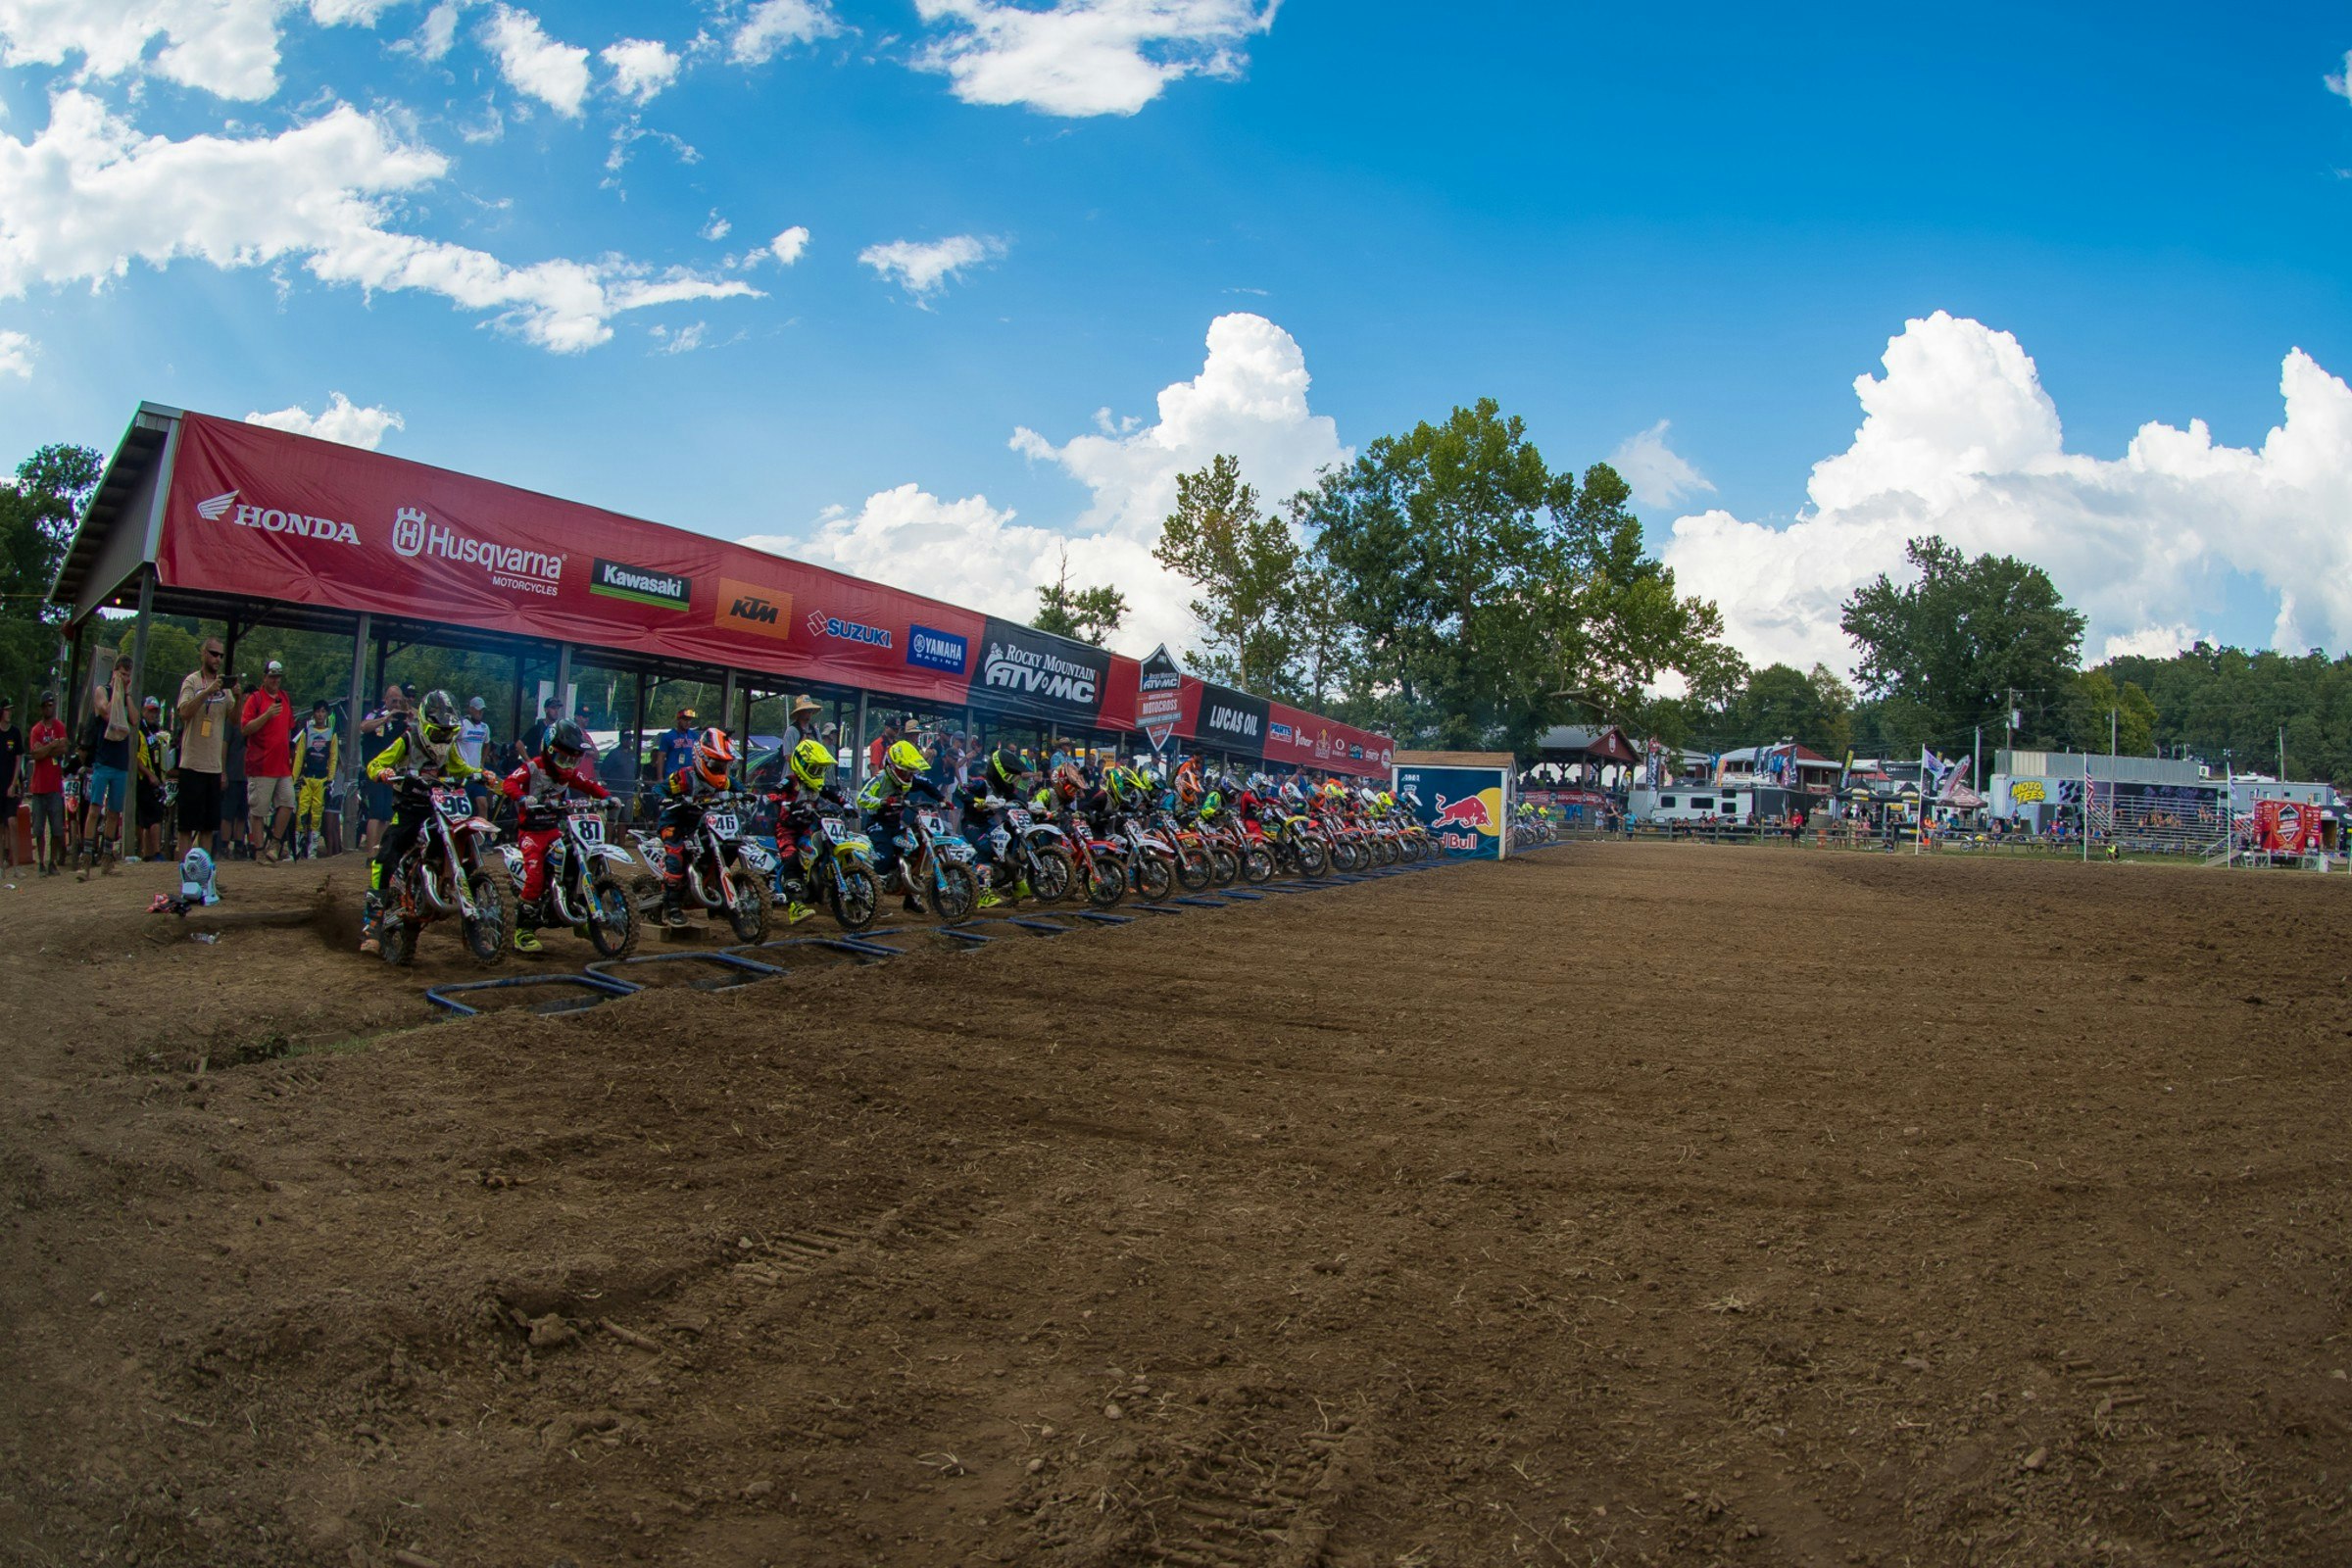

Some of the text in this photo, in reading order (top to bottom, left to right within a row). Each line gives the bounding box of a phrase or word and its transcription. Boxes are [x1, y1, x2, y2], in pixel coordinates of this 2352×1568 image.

[234, 504, 361, 545] HONDA
[427, 524, 563, 580] Husqvarna
[493, 576, 559, 596] MOTORCYCLES
[604, 564, 682, 598] Kawasaki
[729, 596, 779, 624] KTM
[826, 617, 893, 649] SUZUKI
[925, 636, 962, 662] YAMAHA
[915, 653, 959, 666] RACING
[1005, 644, 1097, 681] ROCKY MOUNTAIN
[1143, 700, 1178, 715] MOTOCROSS
[1209, 705, 1258, 736] LUCAS OIL
[2012, 781, 2042, 796] MOTO
[2016, 791, 2045, 805] TEES
[442, 795, 471, 815] 96
[579, 821, 602, 842] 87
[714, 815, 735, 831] 46
[828, 823, 846, 837] 44
[930, 818, 941, 831] 4
[1450, 833, 1477, 850] Bull
[510, 860, 523, 874] 87
[749, 854, 767, 867] 44
